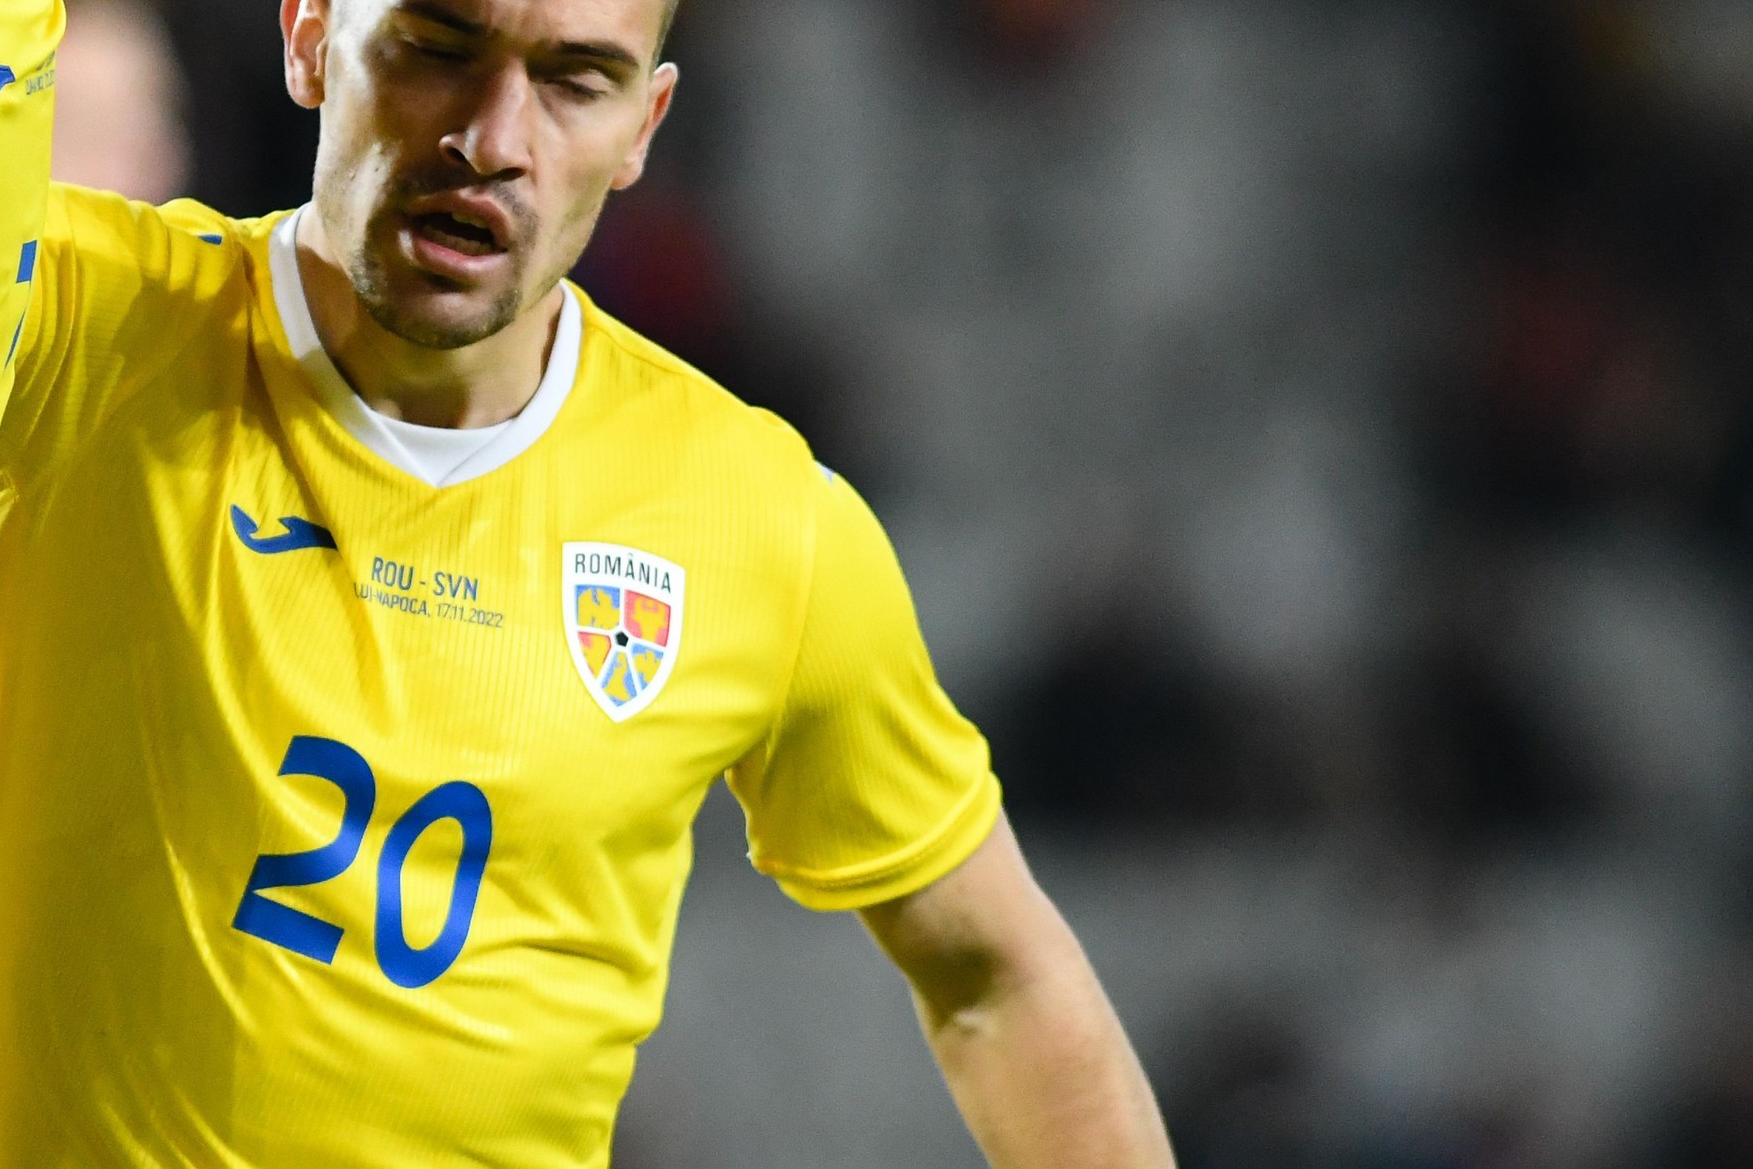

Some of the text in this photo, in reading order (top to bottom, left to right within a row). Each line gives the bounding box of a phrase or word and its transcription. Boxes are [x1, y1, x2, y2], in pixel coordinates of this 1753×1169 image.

[371, 556, 414, 591] ROU
[433, 571, 478, 601] SVN
[575, 552, 672, 594] ROMÂNIA
[231, 734, 493, 990] 20
